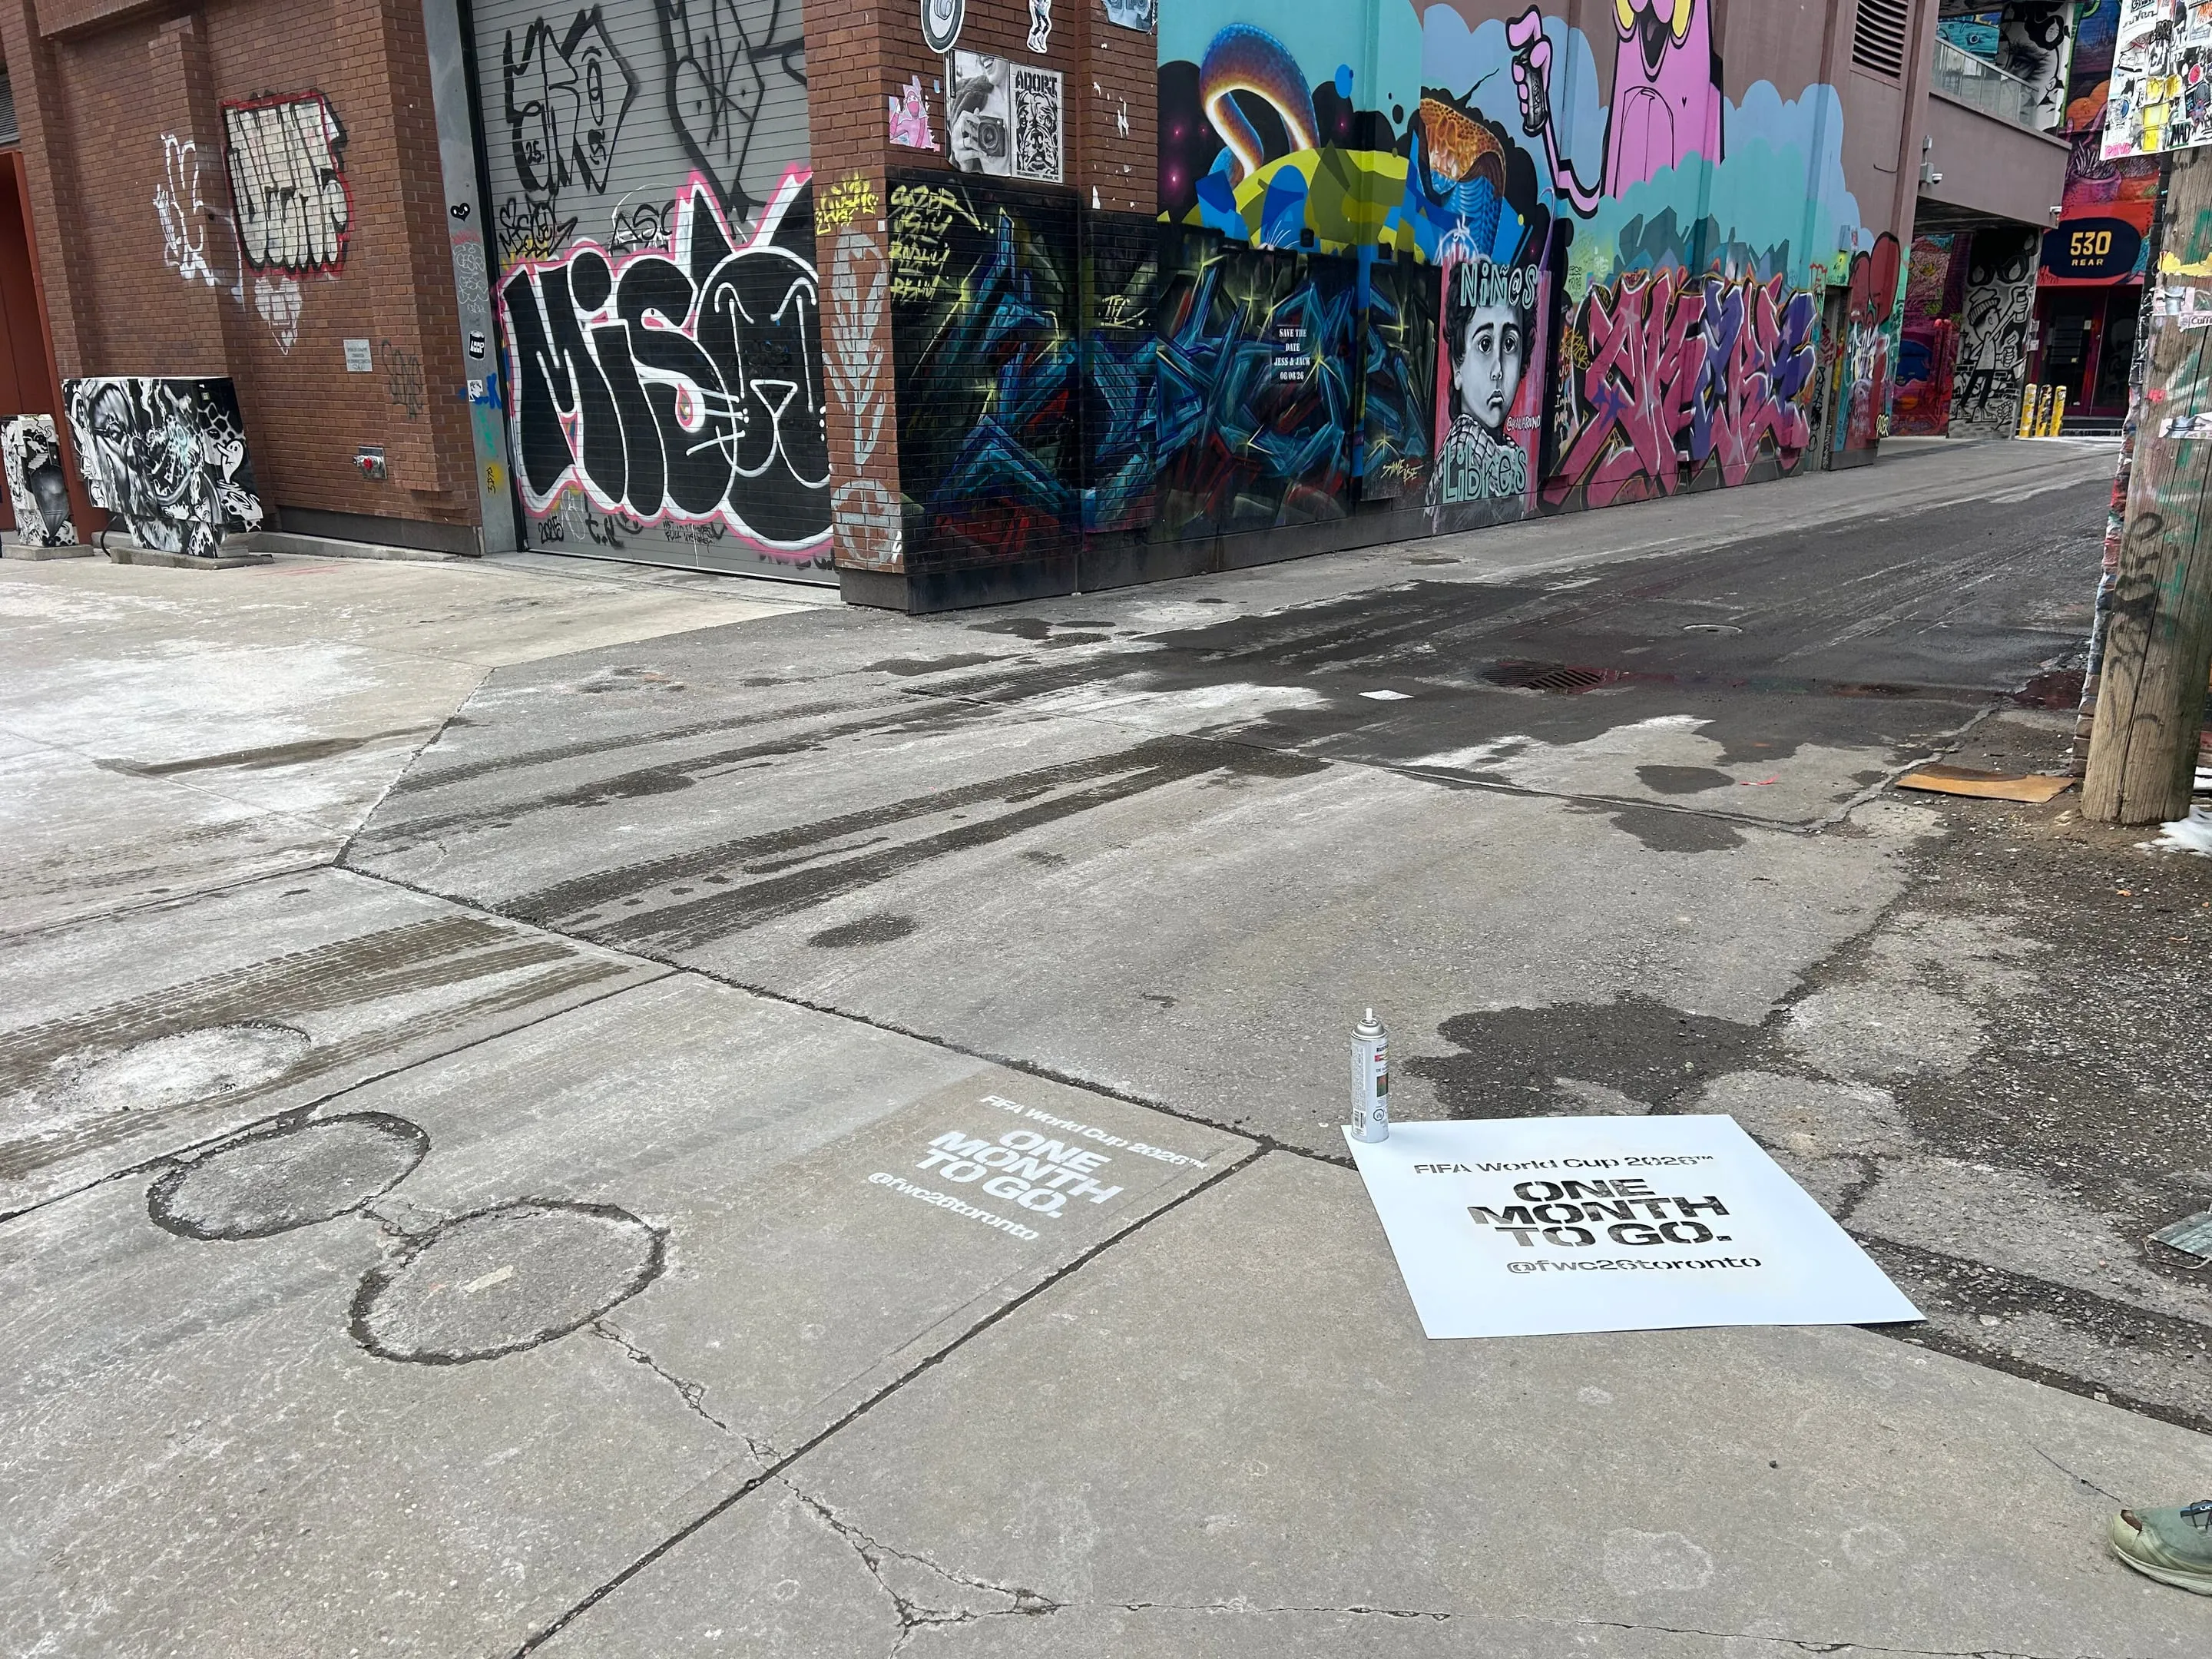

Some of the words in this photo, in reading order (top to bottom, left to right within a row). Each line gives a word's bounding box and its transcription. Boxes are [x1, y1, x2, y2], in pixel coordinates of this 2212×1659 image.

[2070, 231, 2112, 256] 530
[1279, 328, 1294, 337] SAVE
[1295, 328, 1307, 337] THE
[1285, 343, 1300, 352] DATE
[1273, 356, 1289, 366] JESS
[1295, 356, 1310, 366] JACK
[980, 1094, 1026, 1114] FIFA
[1025, 1108, 1087, 1133] World
[1081, 1127, 1129, 1147] Cup
[998, 1130, 1112, 1173] ONE
[927, 1131, 1124, 1204] MONTH
[1414, 1163, 1472, 1174] FIFA
[1475, 1159, 1558, 1173] World
[1561, 1157, 1619, 1169] Cup
[916, 1151, 986, 1183] TO
[982, 1177, 1068, 1218] GO.
[1513, 1178, 1656, 1202] ONE
[868, 1172, 1039, 1241] @fwc26toronto
[1467, 1195, 1730, 1225] MONTH
[1495, 1226, 1596, 1247] TO
[1608, 1220, 1734, 1246] GO.
[1506, 1256, 1763, 1275] @fwc26toronto
